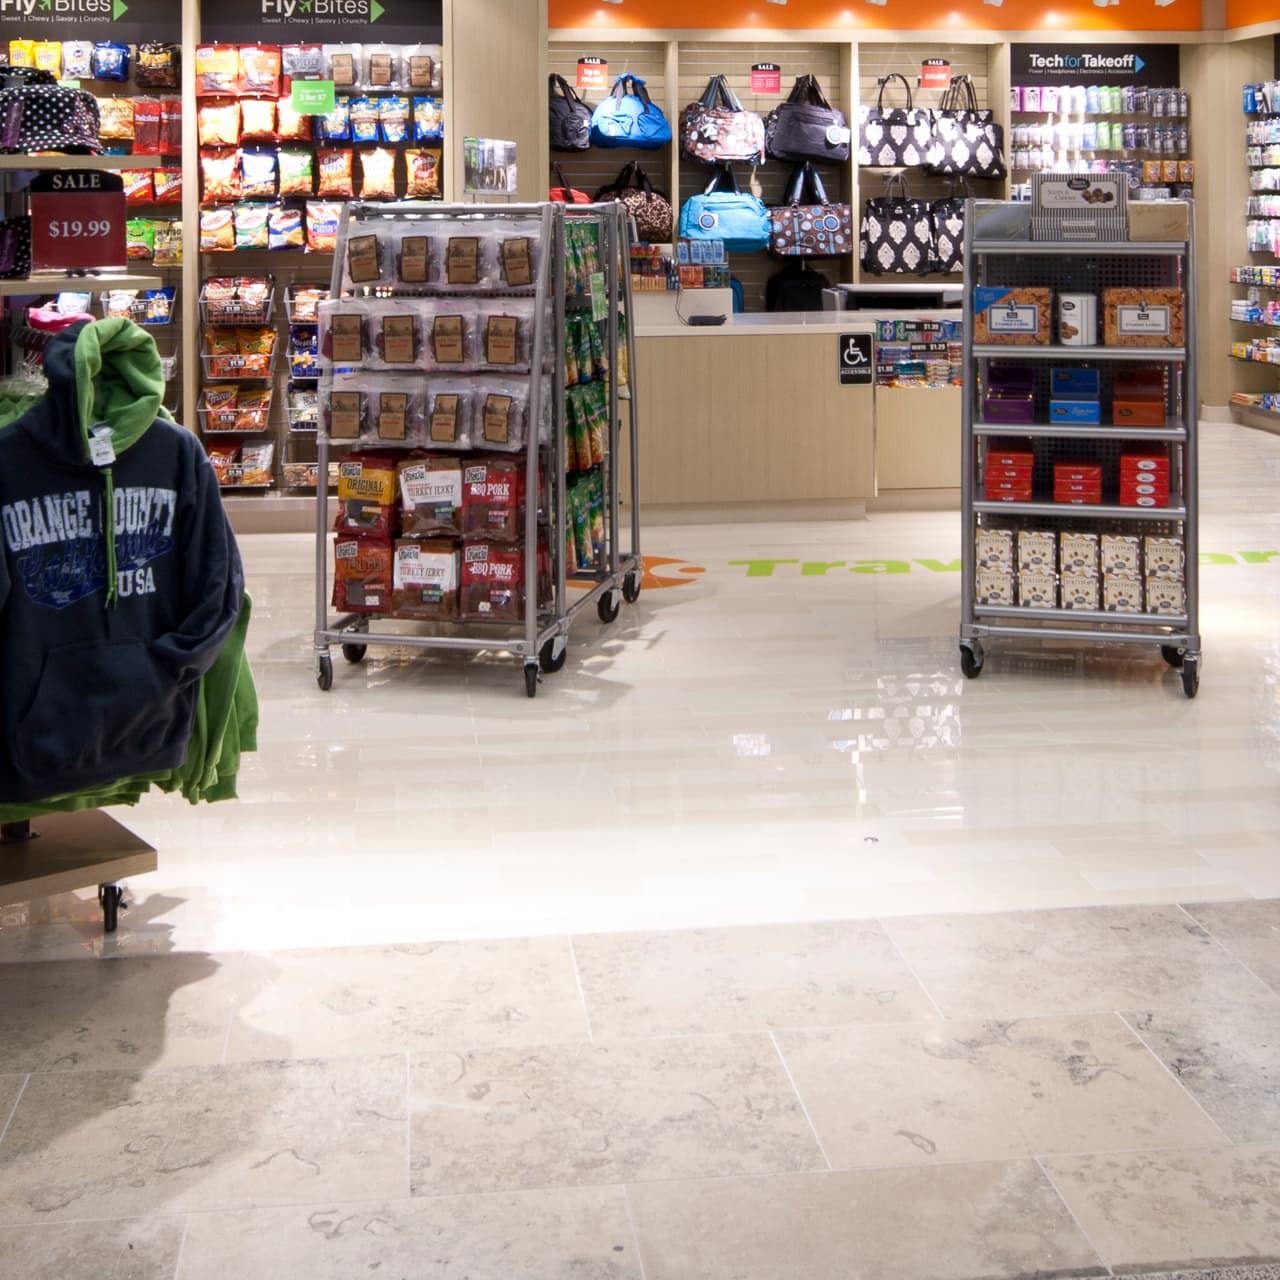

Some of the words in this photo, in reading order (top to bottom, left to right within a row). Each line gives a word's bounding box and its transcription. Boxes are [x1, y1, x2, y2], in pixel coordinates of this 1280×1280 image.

[52, 174, 101, 189] SALE
[48, 219, 112, 239] $19.99
[346, 478, 385, 492] ORIGINAL
[434, 484, 455, 497] JERKY
[487, 483, 510, 497] PORK
[1, 489, 93, 552] ORANGE
[97, 486, 178, 537] OUNTY
[425, 567, 446, 577] JERKY
[489, 563, 513, 576] PORK
[116, 566, 157, 597] USA
